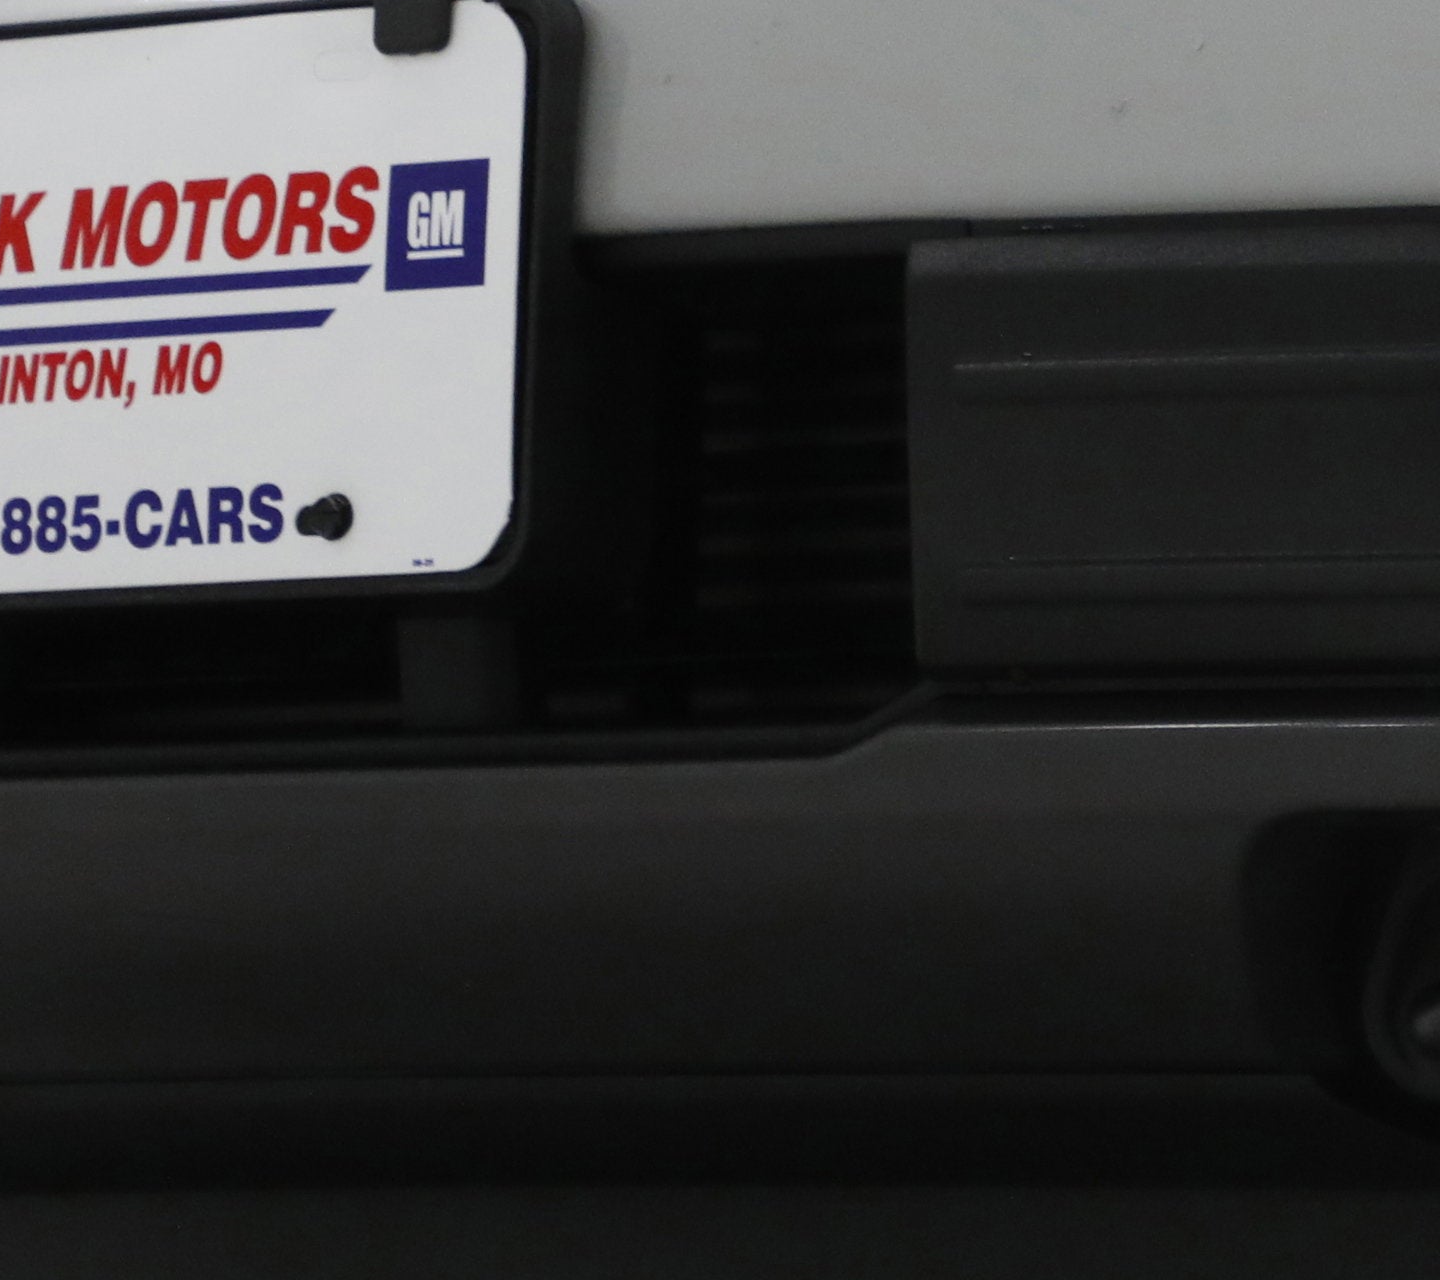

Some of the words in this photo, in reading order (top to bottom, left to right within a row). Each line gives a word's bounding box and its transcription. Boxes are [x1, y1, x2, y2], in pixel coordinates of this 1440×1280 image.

[59, 165, 381, 271] MOTORS
[406, 189, 466, 250] GM
[153, 341, 225, 396] MO
